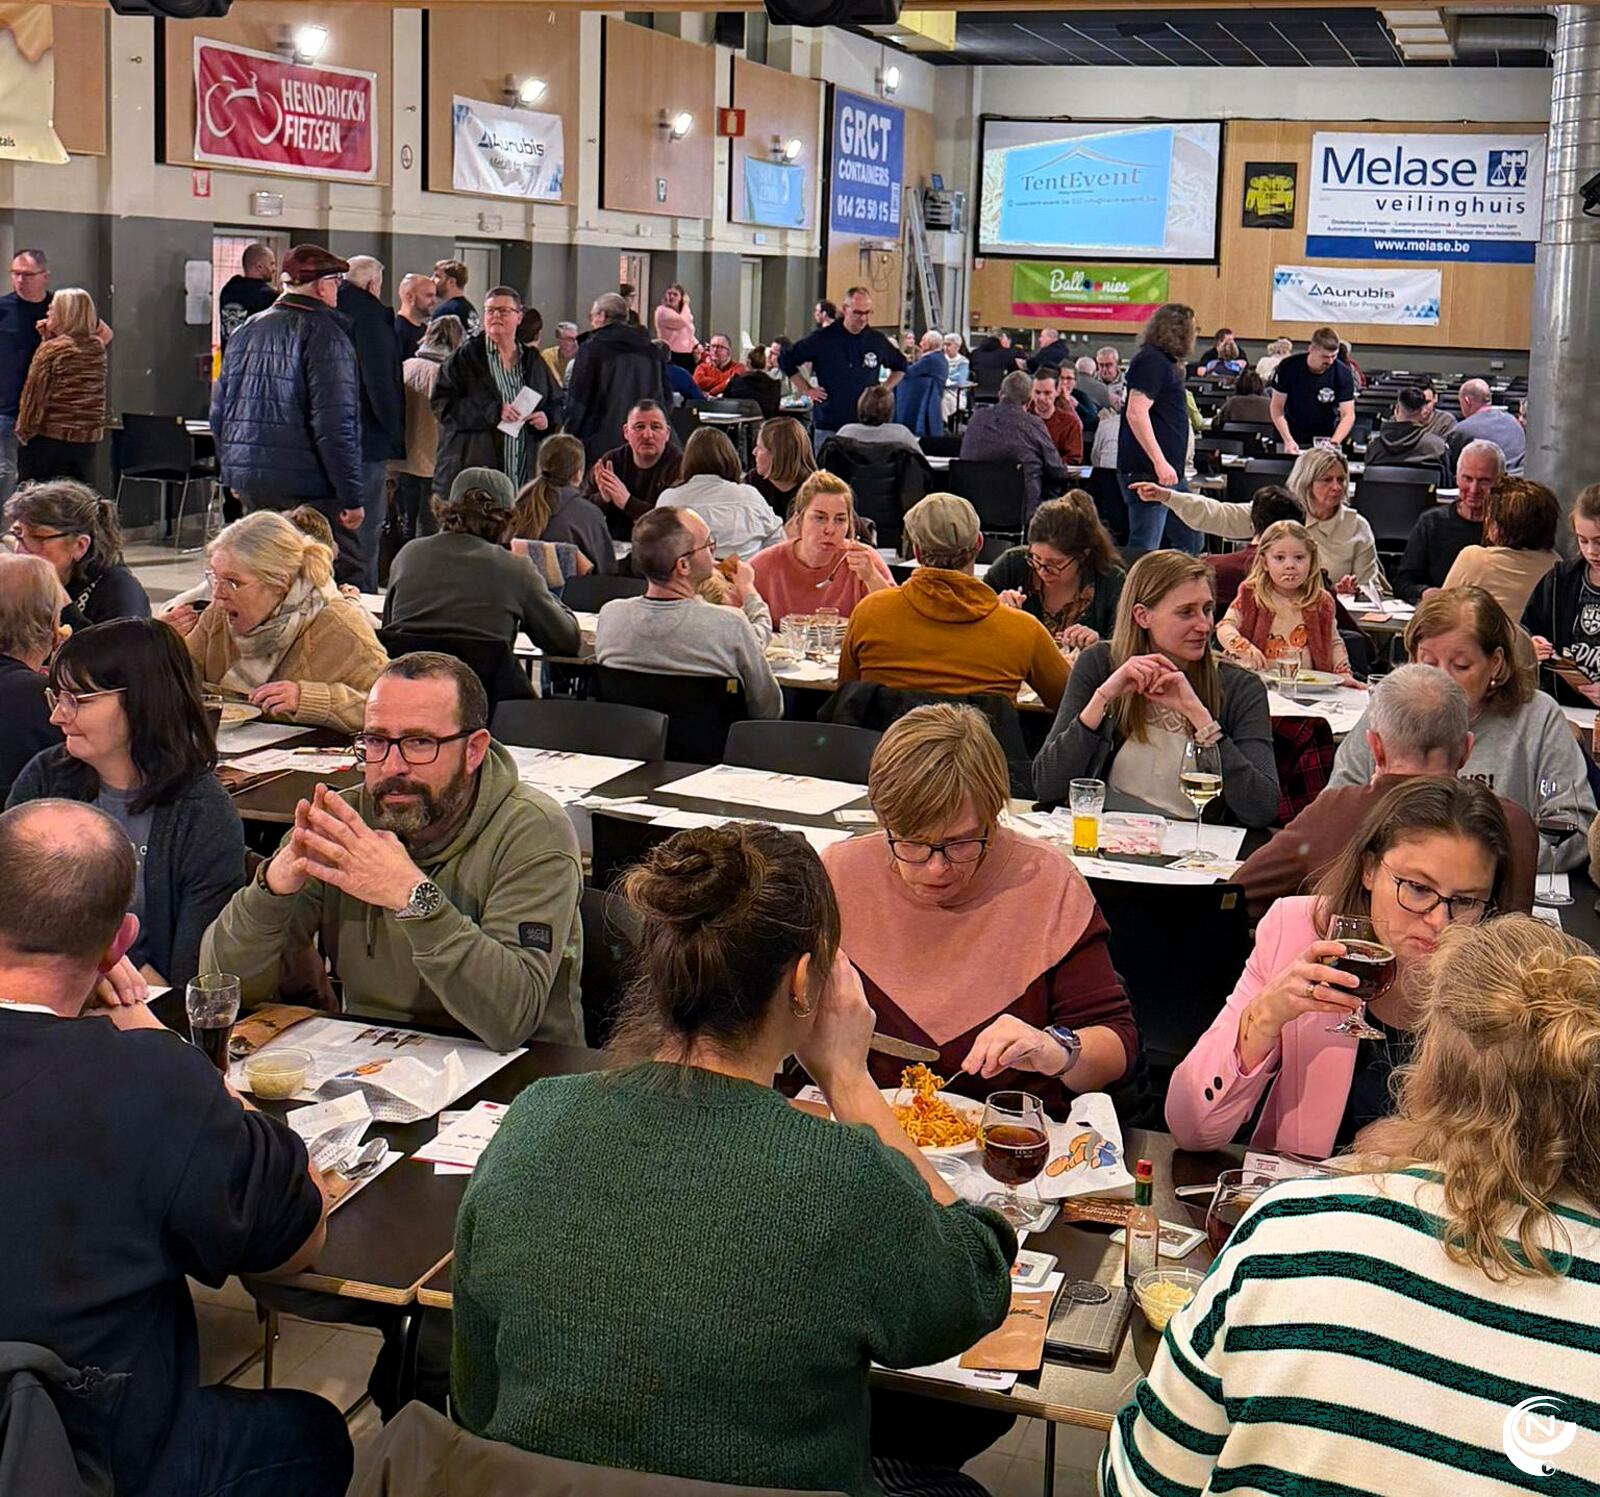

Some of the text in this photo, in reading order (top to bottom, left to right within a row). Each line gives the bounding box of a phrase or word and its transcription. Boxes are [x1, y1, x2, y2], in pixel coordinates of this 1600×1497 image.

[281, 78, 365, 122] HENDRICKX
[282, 113, 342, 153] FIETSEN
[488, 132, 545, 157] Aurubis
[840, 105, 892, 163] GRCT
[838, 158, 889, 187] CONTAINERS
[1021, 167, 1142, 192] TentEvent
[1322, 146, 1477, 188] Melase
[837, 194, 854, 218] 014
[855, 197, 866, 220] 25
[867, 199, 878, 221] 50
[879, 201, 889, 223] 15
[1376, 195, 1526, 218] veilinghuis
[1374, 239, 1471, 254] www.melase.be
[1322, 286, 1395, 298] Aurubis
[1322, 299, 1348, 308] Metals
